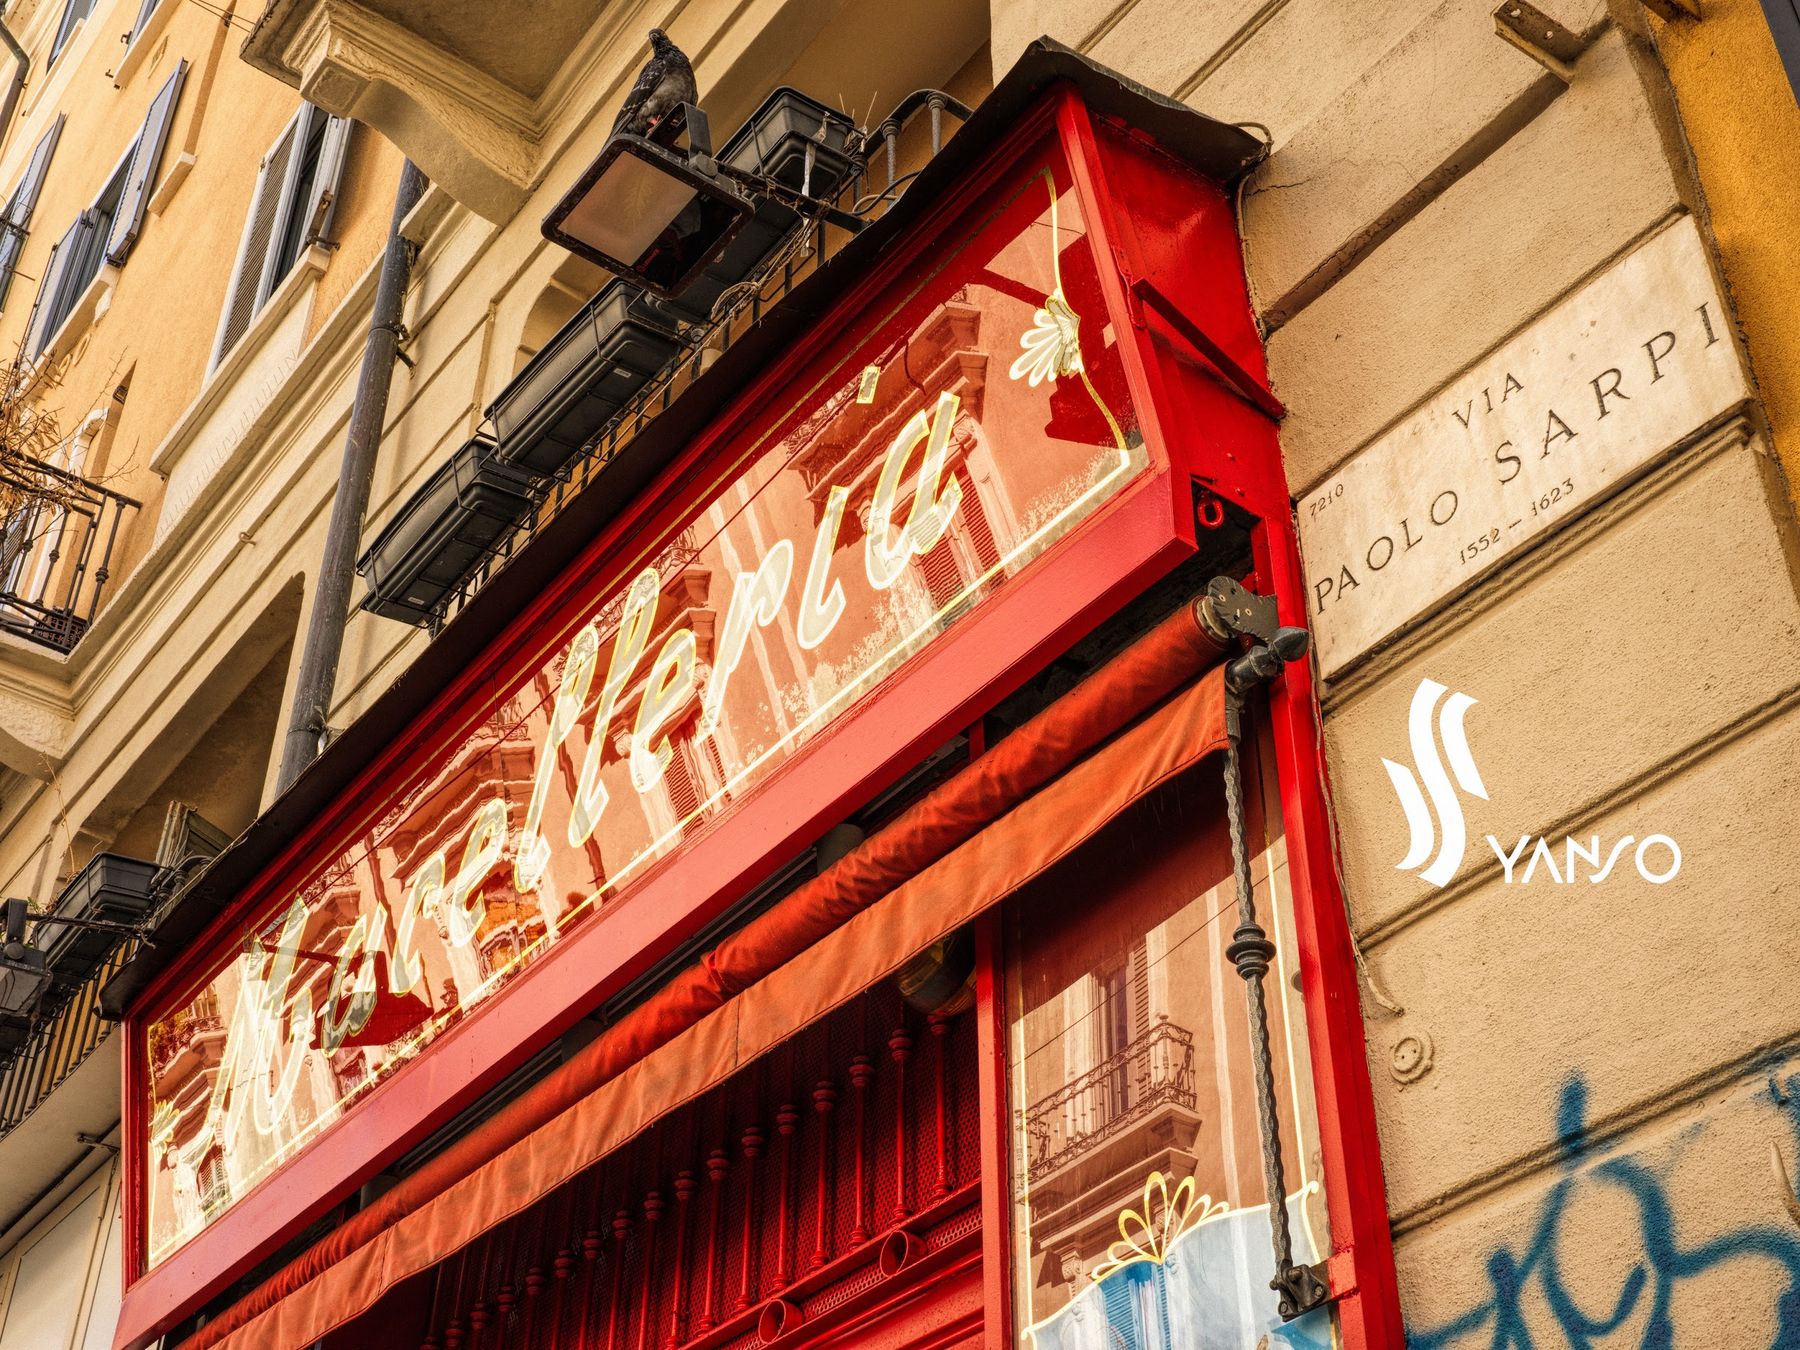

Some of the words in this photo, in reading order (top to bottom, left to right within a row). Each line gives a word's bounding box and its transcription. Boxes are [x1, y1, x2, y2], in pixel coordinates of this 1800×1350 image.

[1452, 372, 1524, 429] VIA
[1309, 483, 1345, 518] 7210
[1314, 490, 1458, 614] PAOLO
[1496, 303, 1720, 484] SARPI
[1459, 528, 1500, 565] 1552
[1531, 477, 1575, 516] 1623
[178, 365, 964, 1164] Macelleria
